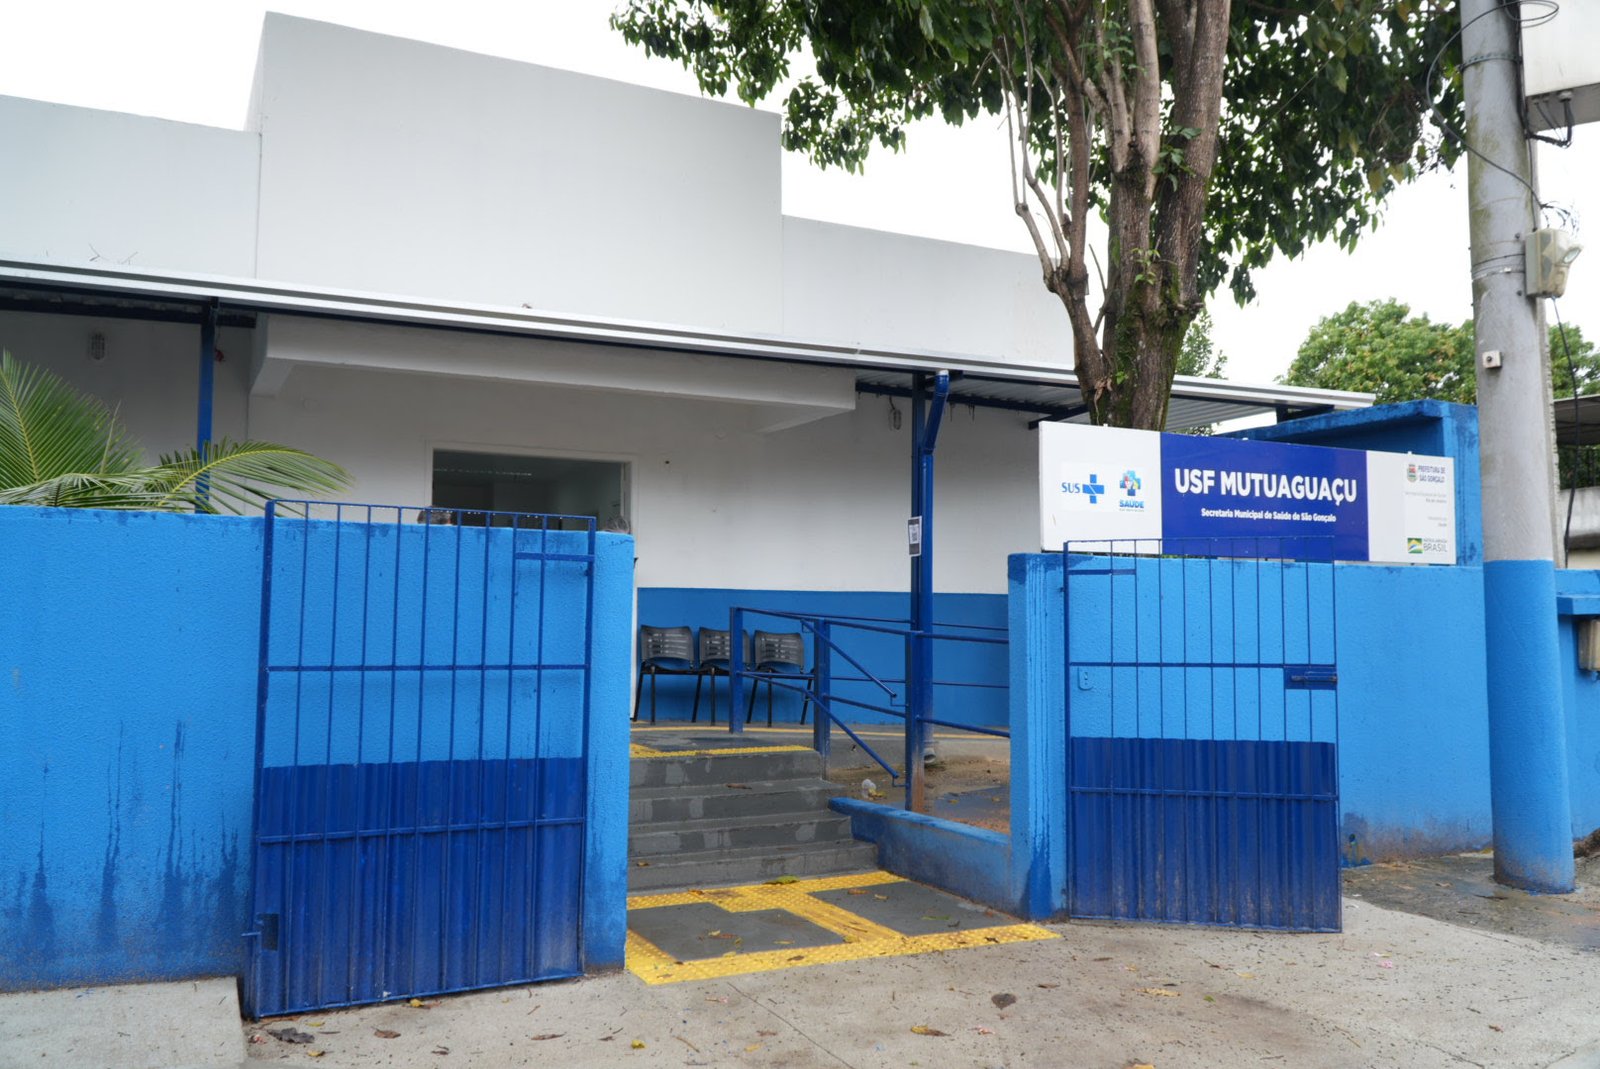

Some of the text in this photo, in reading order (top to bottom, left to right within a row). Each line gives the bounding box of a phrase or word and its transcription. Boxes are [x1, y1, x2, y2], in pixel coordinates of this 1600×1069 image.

[1061, 482, 1080, 493] SUS
[1174, 468, 1357, 506] USF MUTUAGUAÇU
[1201, 508, 1336, 523] Secretaria Municipal de Saúde de São Gonçalo
[1423, 542, 1447, 552] BRASIL
